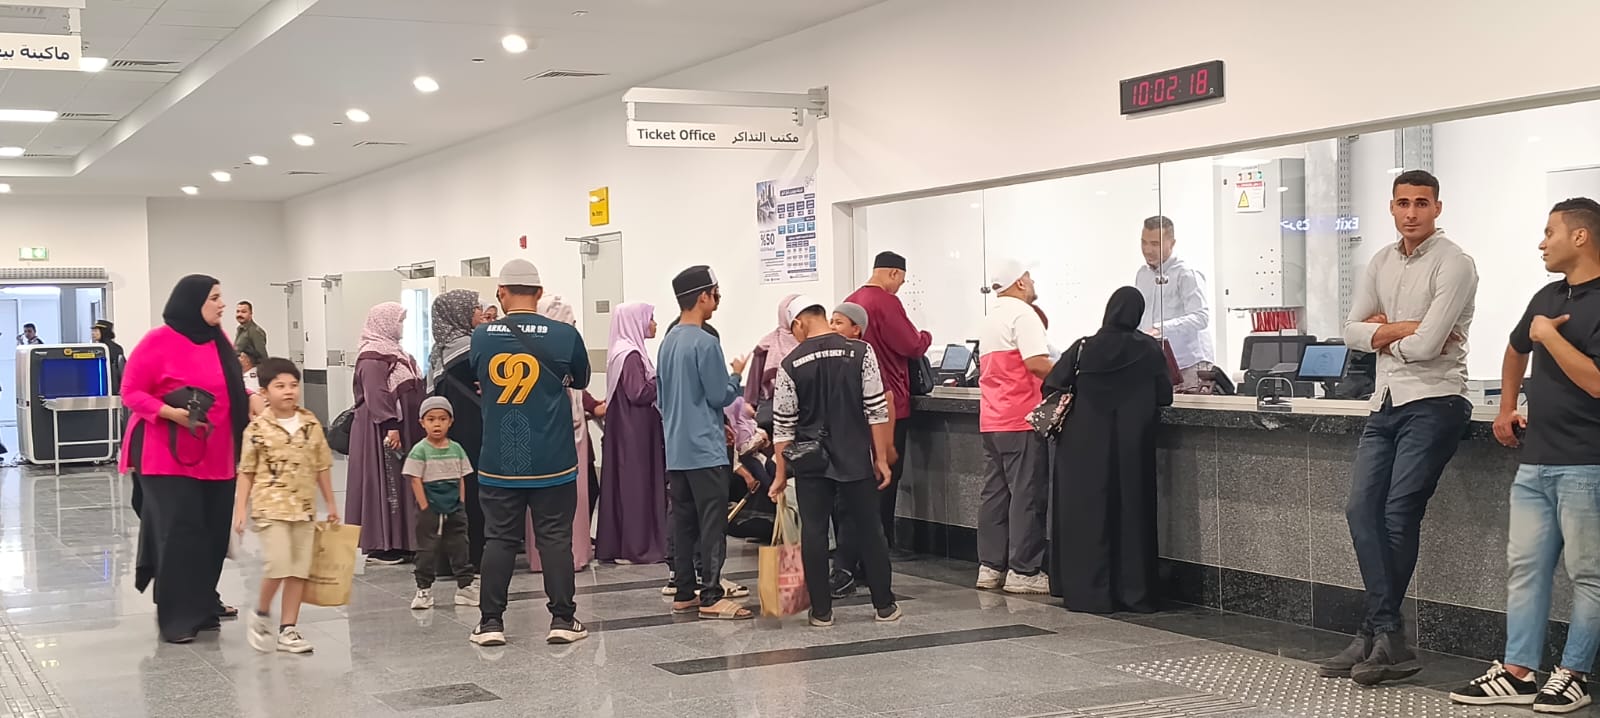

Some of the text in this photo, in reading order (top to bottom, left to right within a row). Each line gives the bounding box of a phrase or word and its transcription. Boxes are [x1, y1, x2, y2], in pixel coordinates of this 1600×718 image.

[0, 44, 70, 62] ماكينة بي
[637, 128, 716, 141] Ticket Office
[731, 131, 799, 144] مكتب التذاكر
[489, 352, 541, 405] 99
